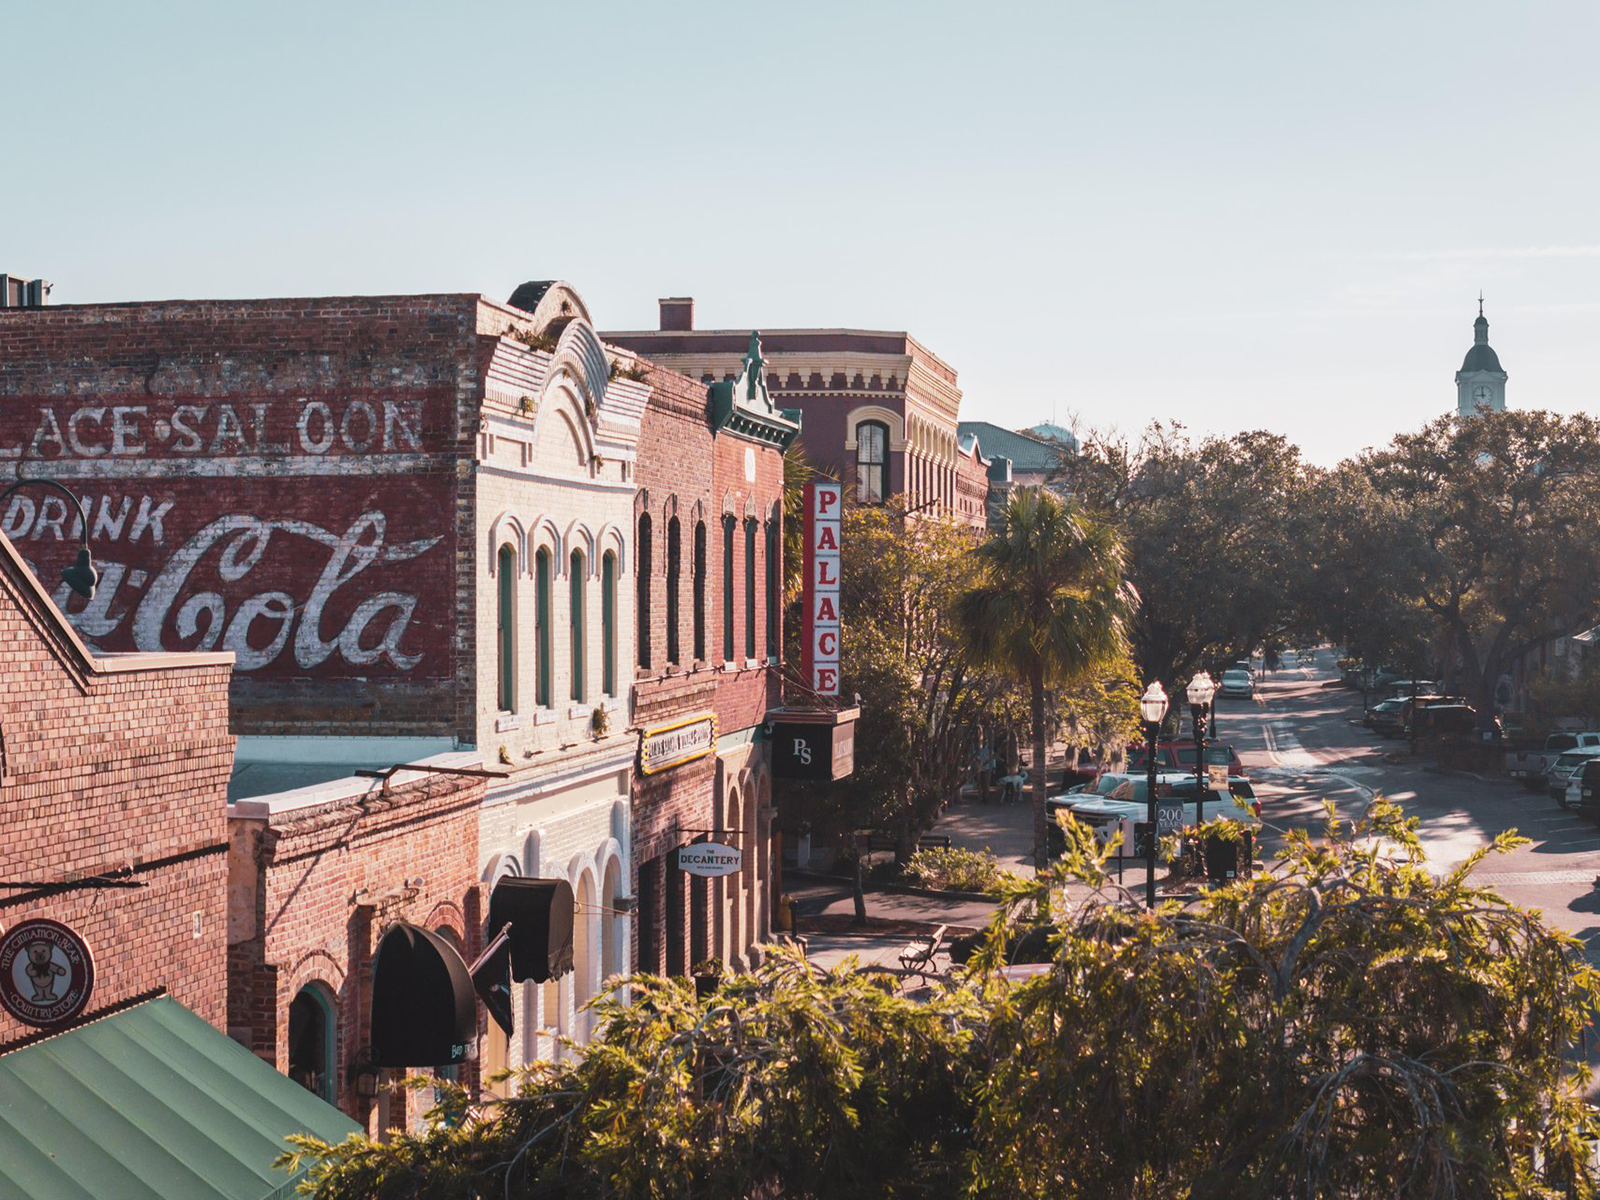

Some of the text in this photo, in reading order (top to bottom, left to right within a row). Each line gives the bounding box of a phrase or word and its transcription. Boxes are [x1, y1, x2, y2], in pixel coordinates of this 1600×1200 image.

[1, 494, 175, 546] DRINK
[816, 490, 838, 692] PALACE
[1159, 809, 1183, 821] 200
[680, 854, 740, 865] DECANTERY
[1, 929, 80, 970] THE CINNAMON BEAR
[10, 991, 79, 1018] COUNTRY STORE
